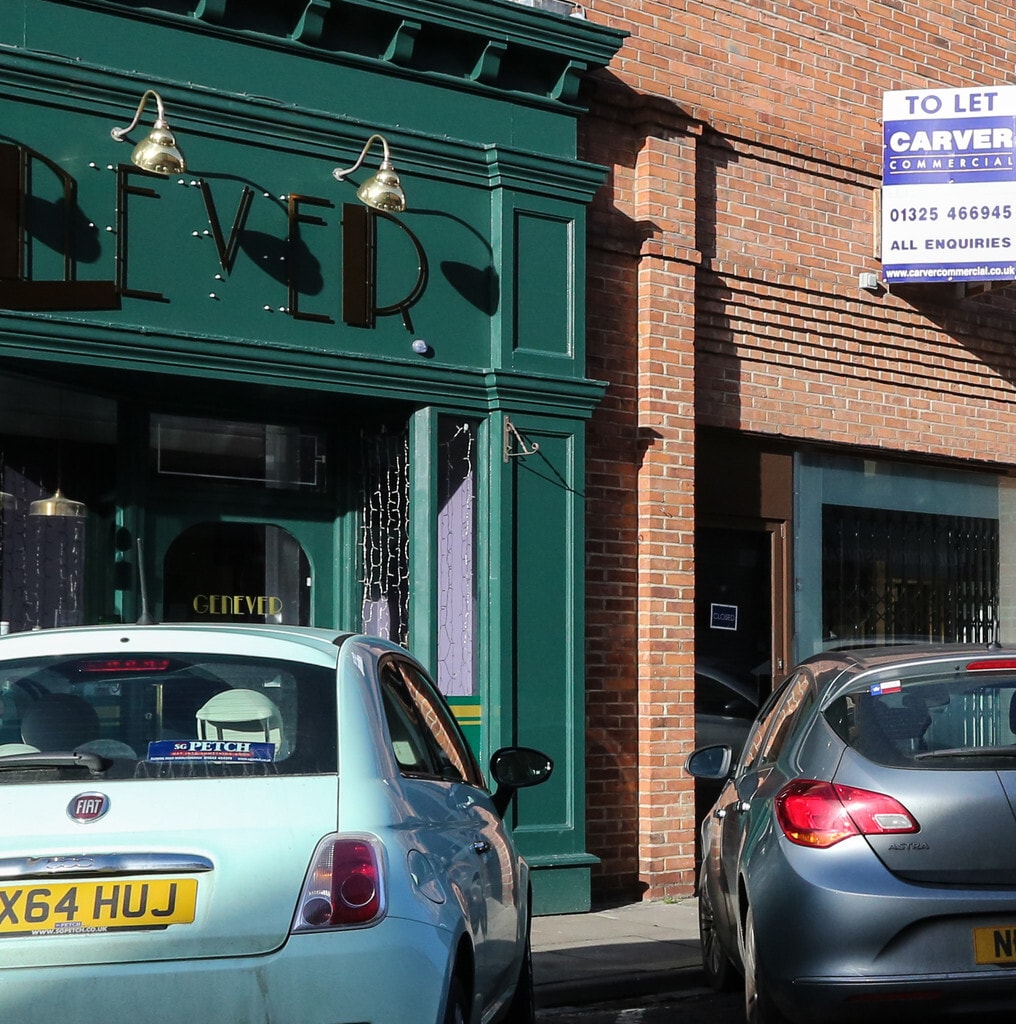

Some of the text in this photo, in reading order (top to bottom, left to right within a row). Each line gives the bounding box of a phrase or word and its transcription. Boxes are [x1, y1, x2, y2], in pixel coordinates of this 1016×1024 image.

[905, 92, 998, 114] TO LET
[889, 128, 1014, 153] CARVER
[889, 157, 1013, 170] COMMERCIAL
[890, 205, 1012, 222] 01325 466945
[890, 237, 1011, 251] ALL ENQUIRIES
[886, 266, 1015, 278] www.carvercommercial.co.uk
[193, 594, 283, 616] GENEVER
[713, 612, 735, 622] CLOSED
[189, 741, 252, 752] PETCH
[76, 799, 102, 814] FIAT
[888, 842, 930, 850] ASTRA
[92, 883, 177, 920] HUJ
